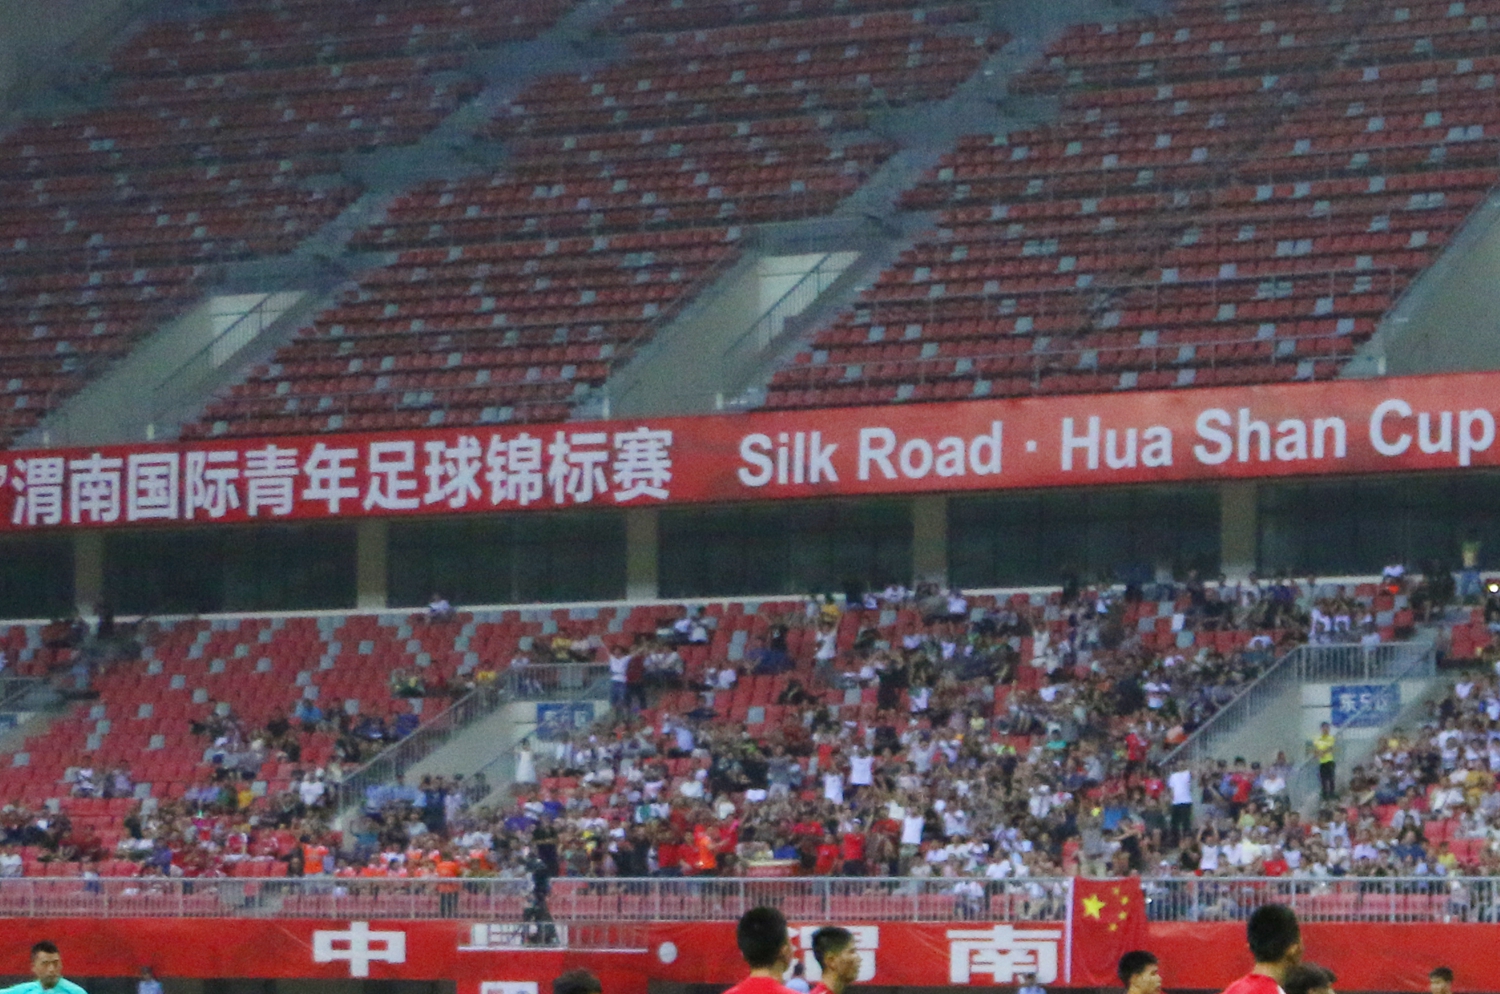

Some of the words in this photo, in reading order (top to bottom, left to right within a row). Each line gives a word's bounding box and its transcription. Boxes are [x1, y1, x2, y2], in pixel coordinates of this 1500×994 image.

[738, 430, 839, 487] Silk
[857, 420, 1003, 481] Road
[1060, 413, 1173, 471] Hua
[1193, 406, 1347, 465] Shan
[1368, 397, 1496, 467] Cup
